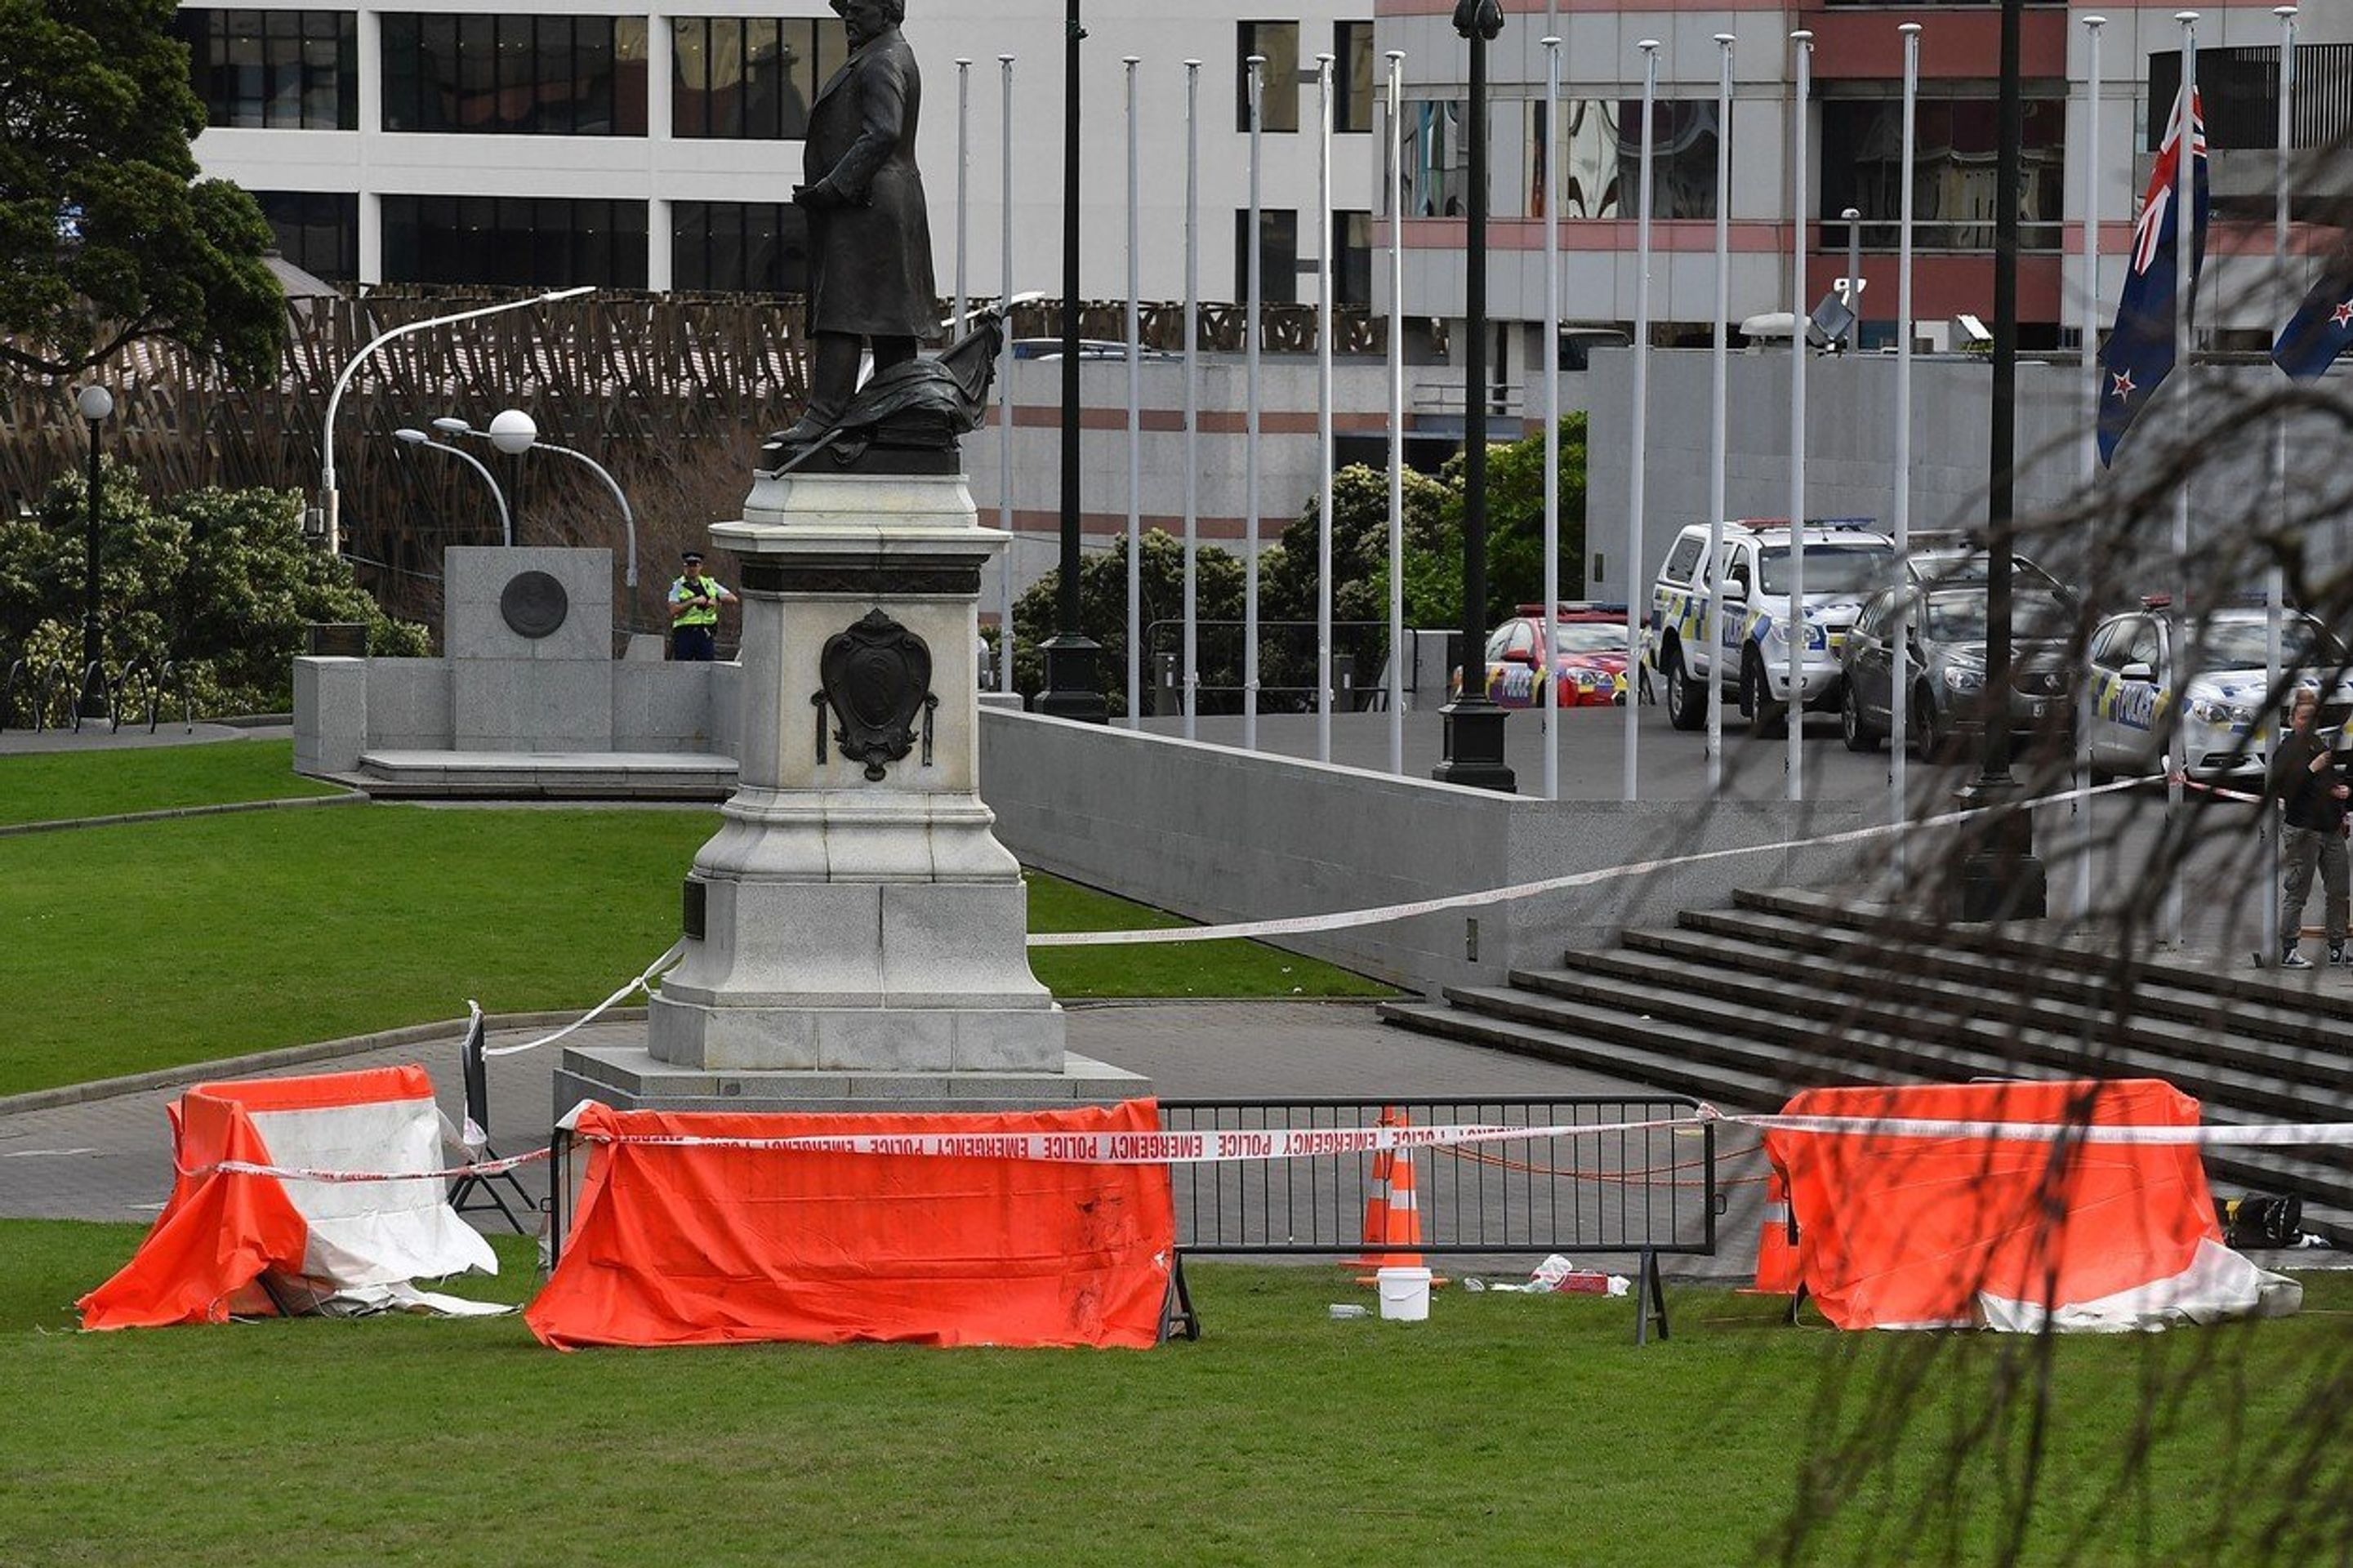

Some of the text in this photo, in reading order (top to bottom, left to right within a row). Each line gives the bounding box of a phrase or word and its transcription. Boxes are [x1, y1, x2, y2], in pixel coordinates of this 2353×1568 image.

[870, 1138, 924, 1156] POLICE
[938, 1137, 1029, 1159] EMERGENCY
[1044, 1136, 1097, 1159] POLICE
[1109, 1134, 1202, 1159] EMERGENCY
[1218, 1134, 1272, 1157] POLICE
[1282, 1132, 1377, 1155] EMERGENCY
